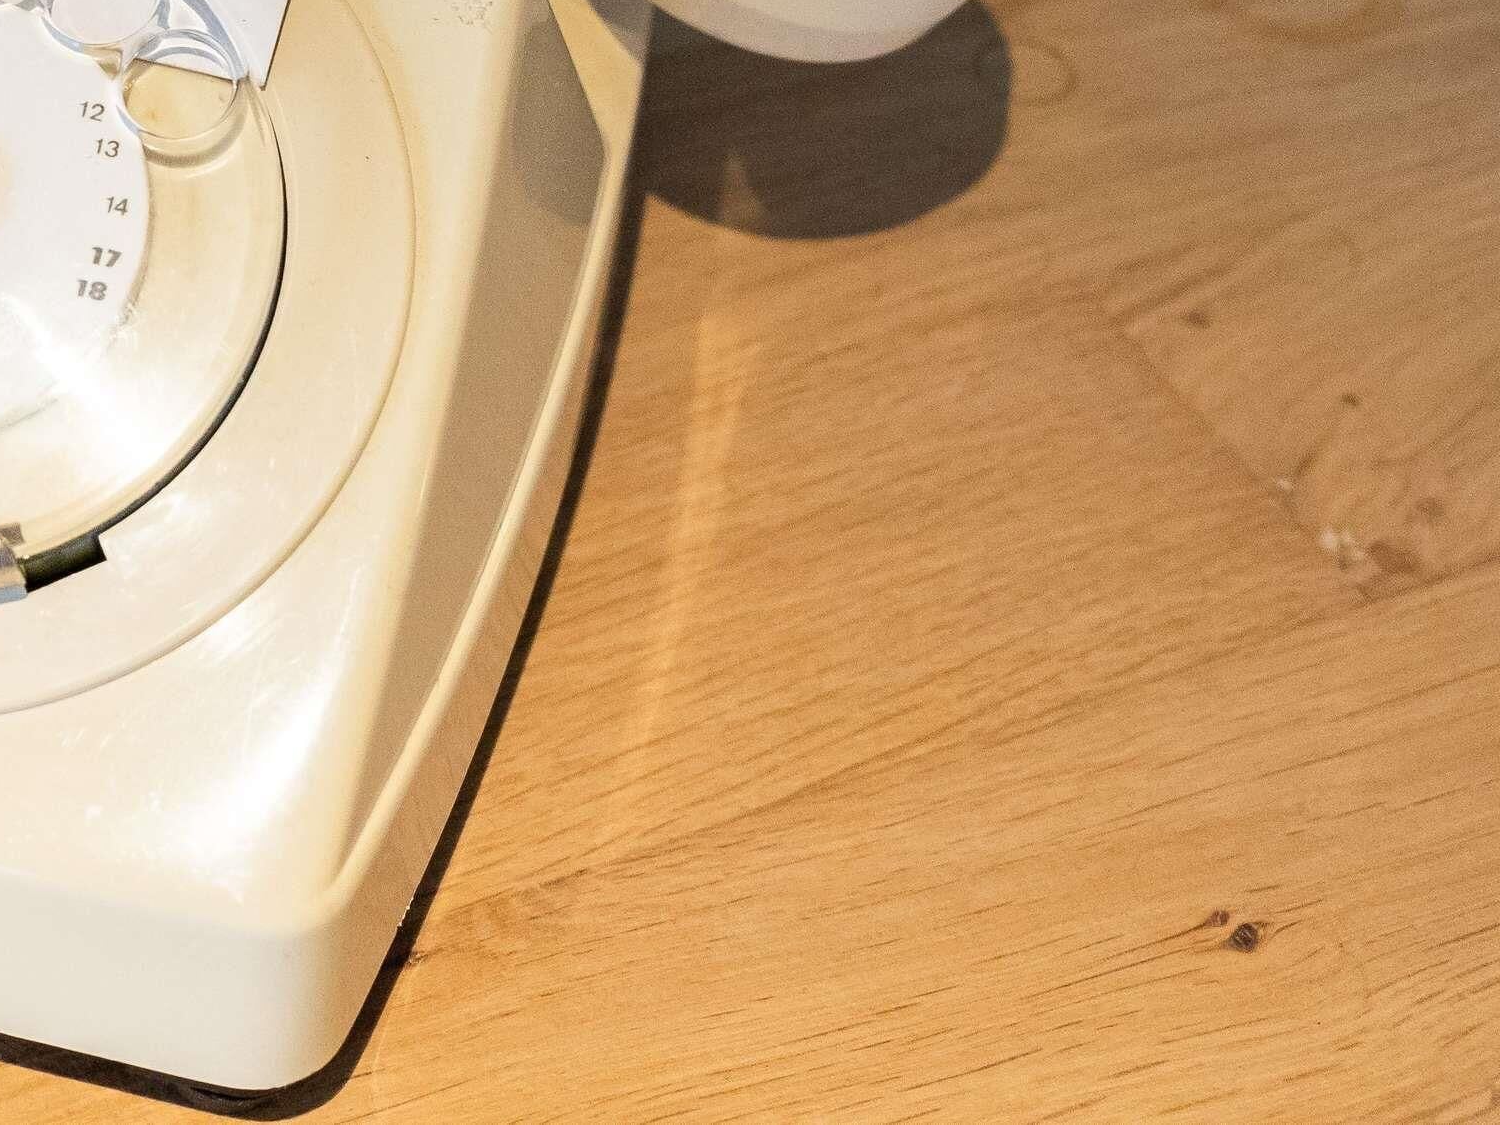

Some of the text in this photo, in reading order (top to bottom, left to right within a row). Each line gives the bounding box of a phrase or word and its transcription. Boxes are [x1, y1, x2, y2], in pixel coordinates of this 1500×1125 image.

[80, 101, 105, 122] 12
[95, 138, 120, 158] 13
[105, 196, 128, 216] 14
[91, 246, 122, 268] 17
[76, 279, 108, 301] 18
